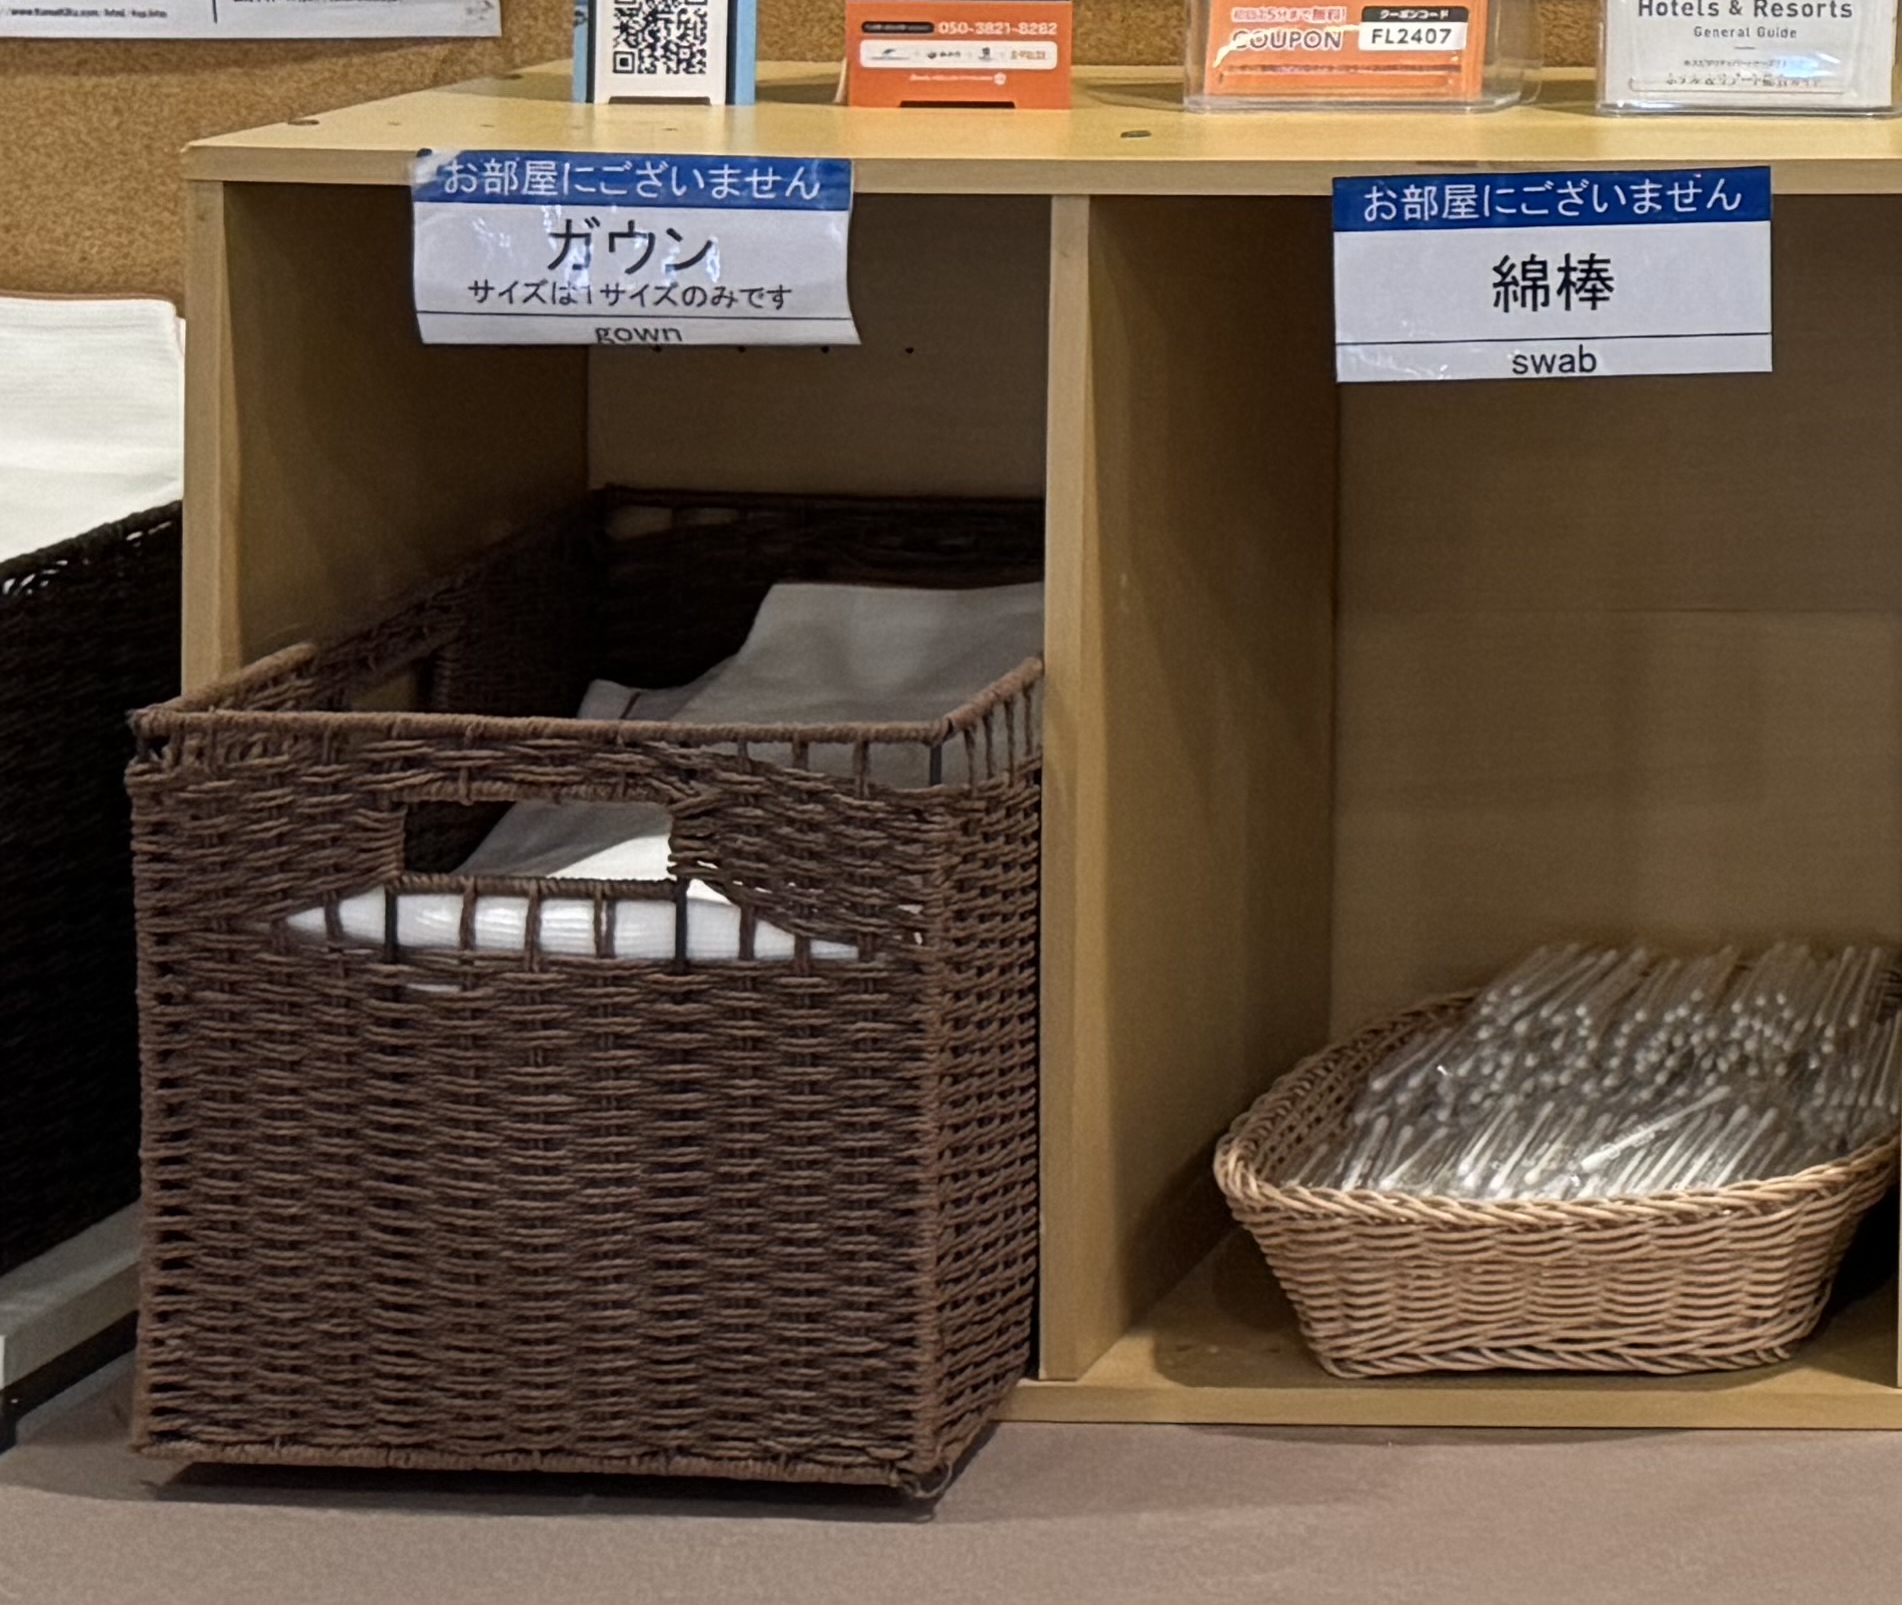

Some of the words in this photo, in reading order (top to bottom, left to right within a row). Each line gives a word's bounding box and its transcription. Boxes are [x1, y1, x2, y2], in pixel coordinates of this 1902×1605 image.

[1729, 0, 1742, 15] &
[1371, 27, 1451, 45] FL2407
[1694, 26, 1750, 37] General
[1757, 26, 1797, 38] Guide
[444, 160, 821, 200] お部屋にございません
[1363, 179, 1742, 221] お部屋にございません
[547, 216, 715, 275] ガウン
[1492, 252, 1615, 313] 綿棒
[595, 326, 683, 343] gown
[1512, 344, 1597, 374] swab
